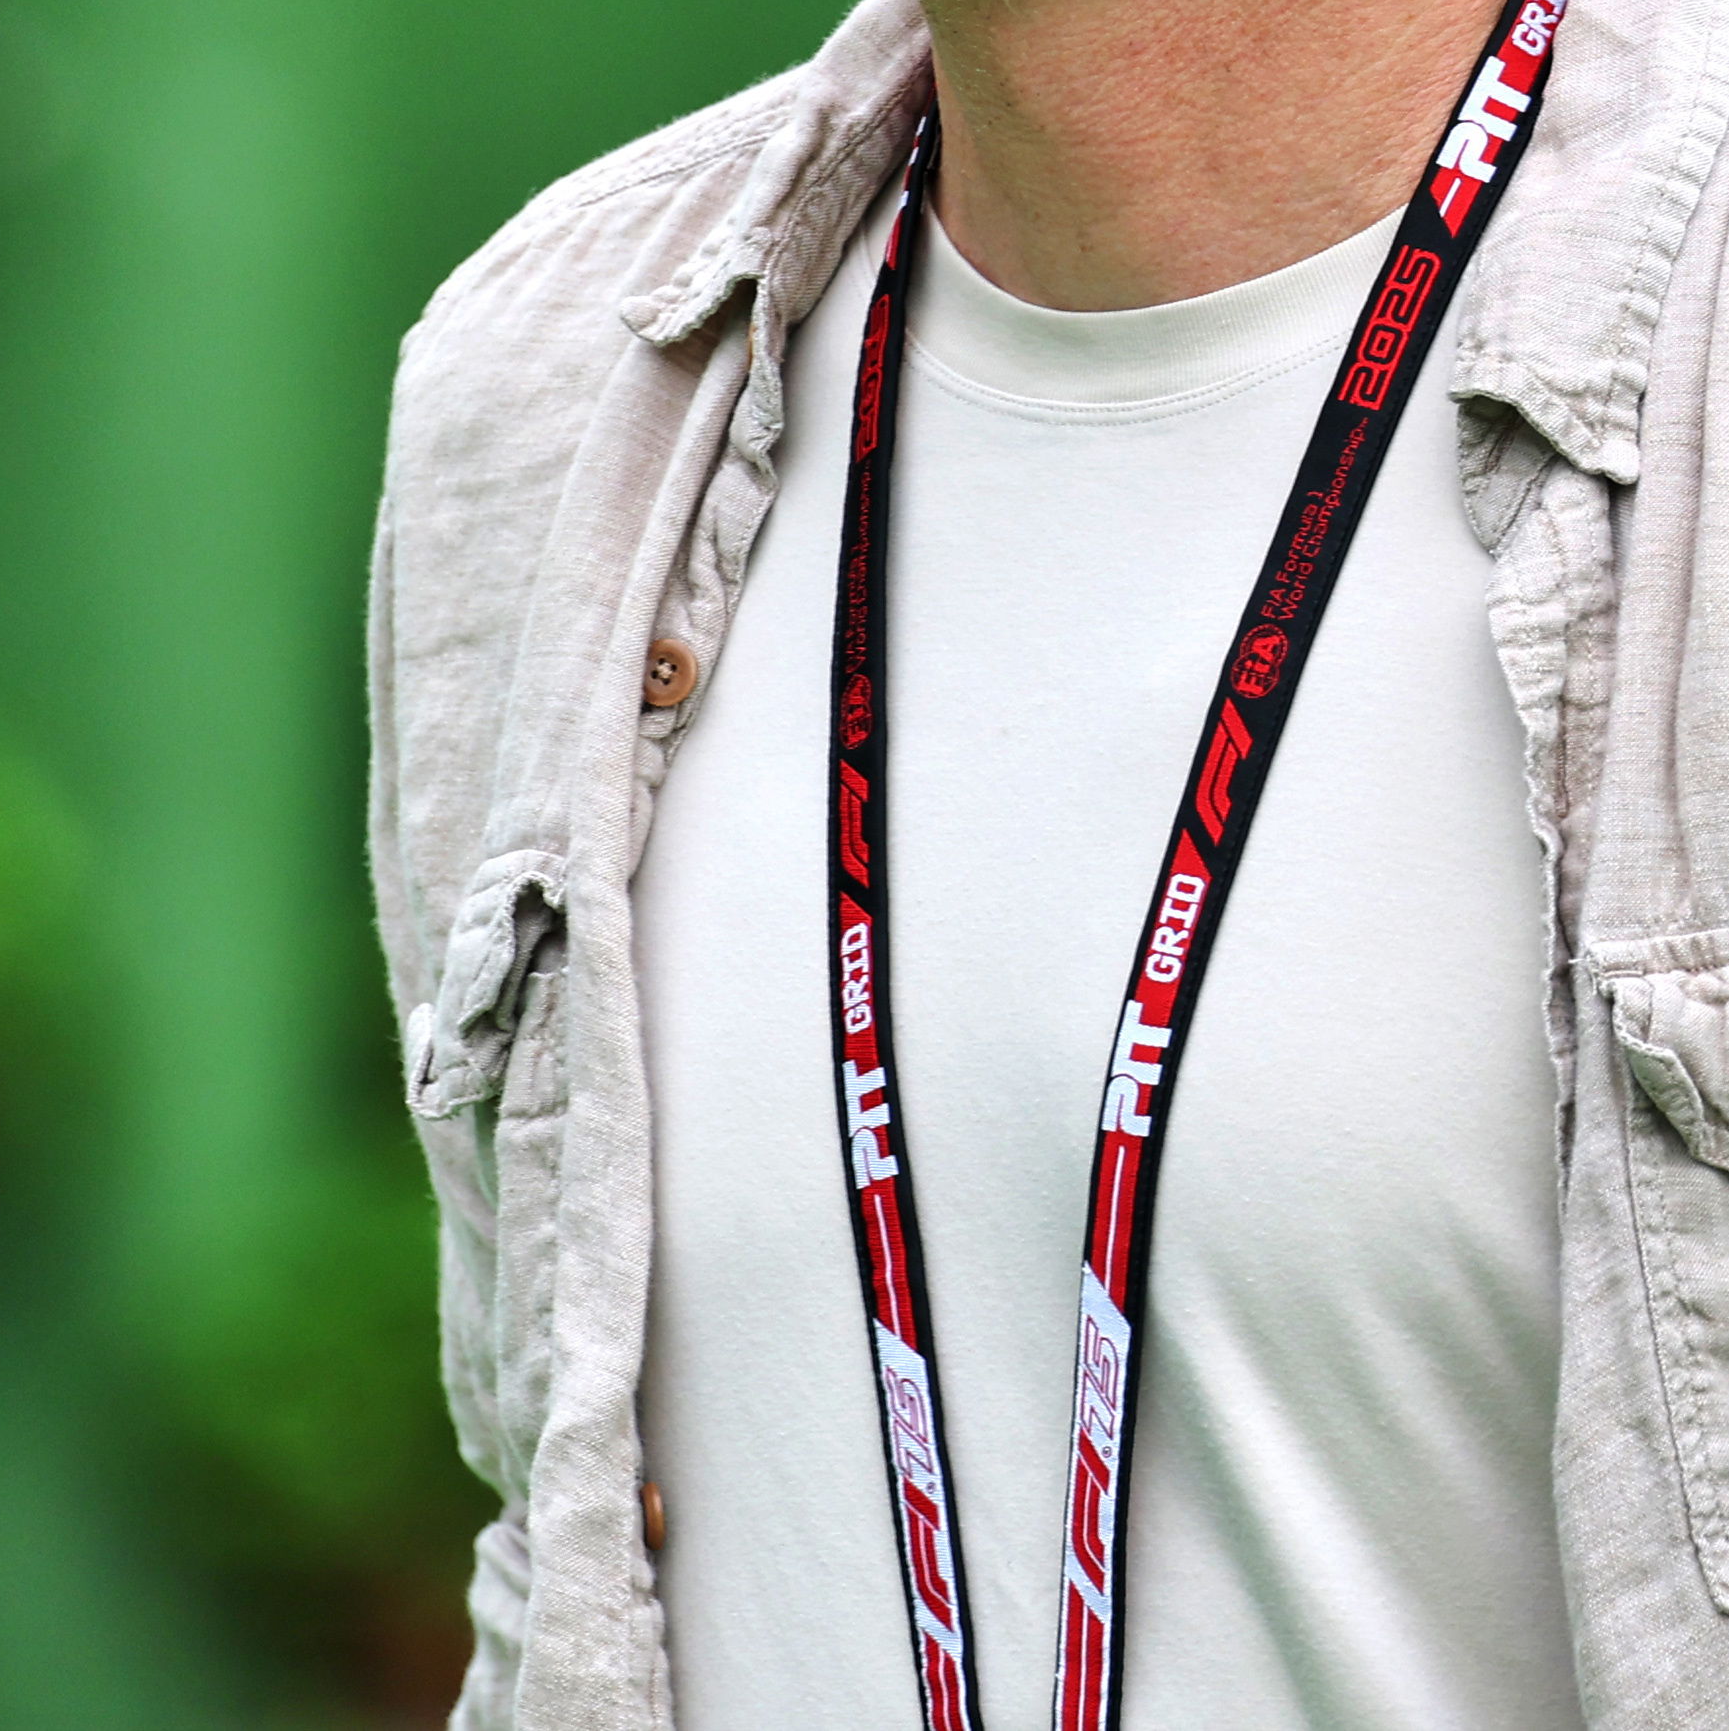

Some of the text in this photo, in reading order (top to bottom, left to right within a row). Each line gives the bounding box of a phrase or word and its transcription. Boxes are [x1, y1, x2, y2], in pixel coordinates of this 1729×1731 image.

[1436, 56, 1531, 184] PIT
[1338, 245, 1441, 411] 2025
[1260, 588, 1286, 618] FIA
[1276, 504, 1318, 583] Formula
[1278, 562, 1314, 620] World
[1196, 698, 1253, 847] F1
[841, 922, 899, 1189] PIT GRID
[1101, 873, 1206, 1137] PIT GRID
